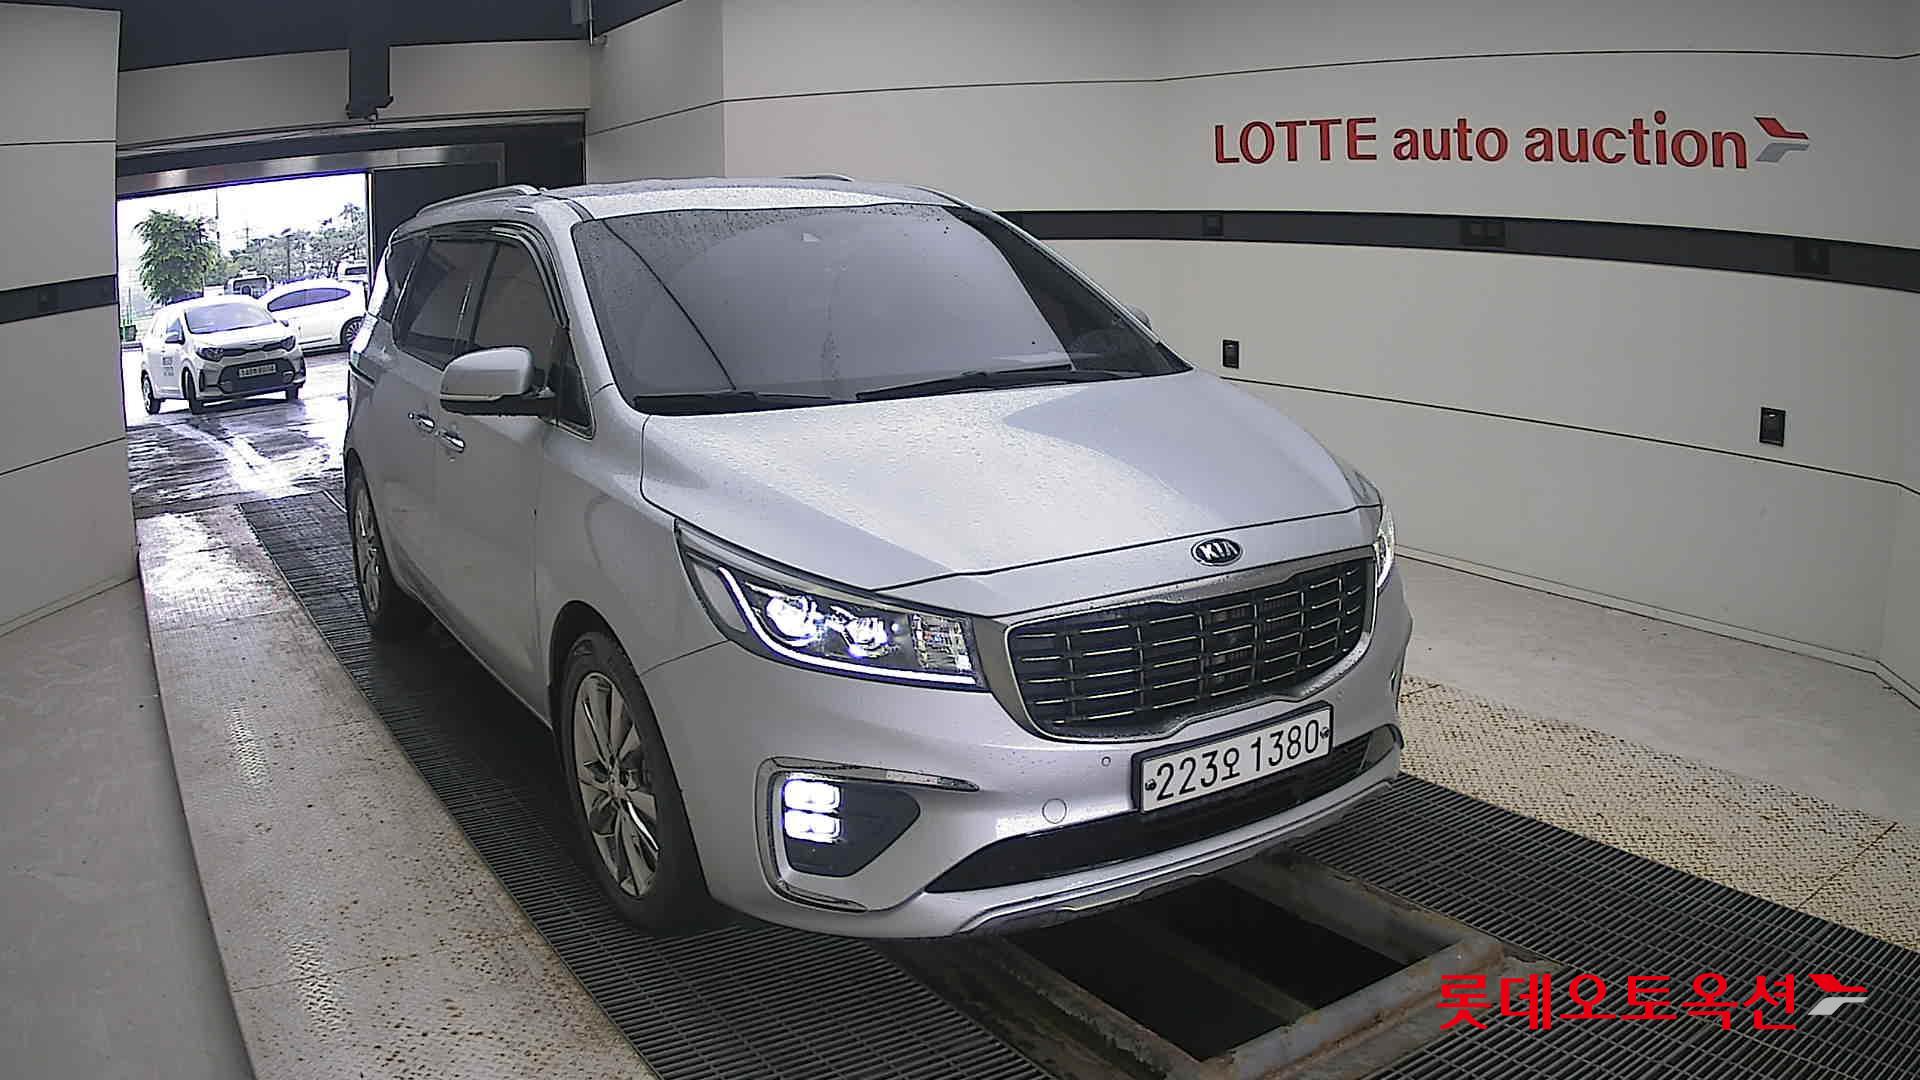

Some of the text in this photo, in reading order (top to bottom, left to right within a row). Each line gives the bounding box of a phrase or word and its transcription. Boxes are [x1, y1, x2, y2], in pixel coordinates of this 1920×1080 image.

[1214, 110, 1748, 169] LOTTE auto auction
[1198, 541, 1239, 560] KIA
[1156, 719, 1320, 801] 223오 1380
